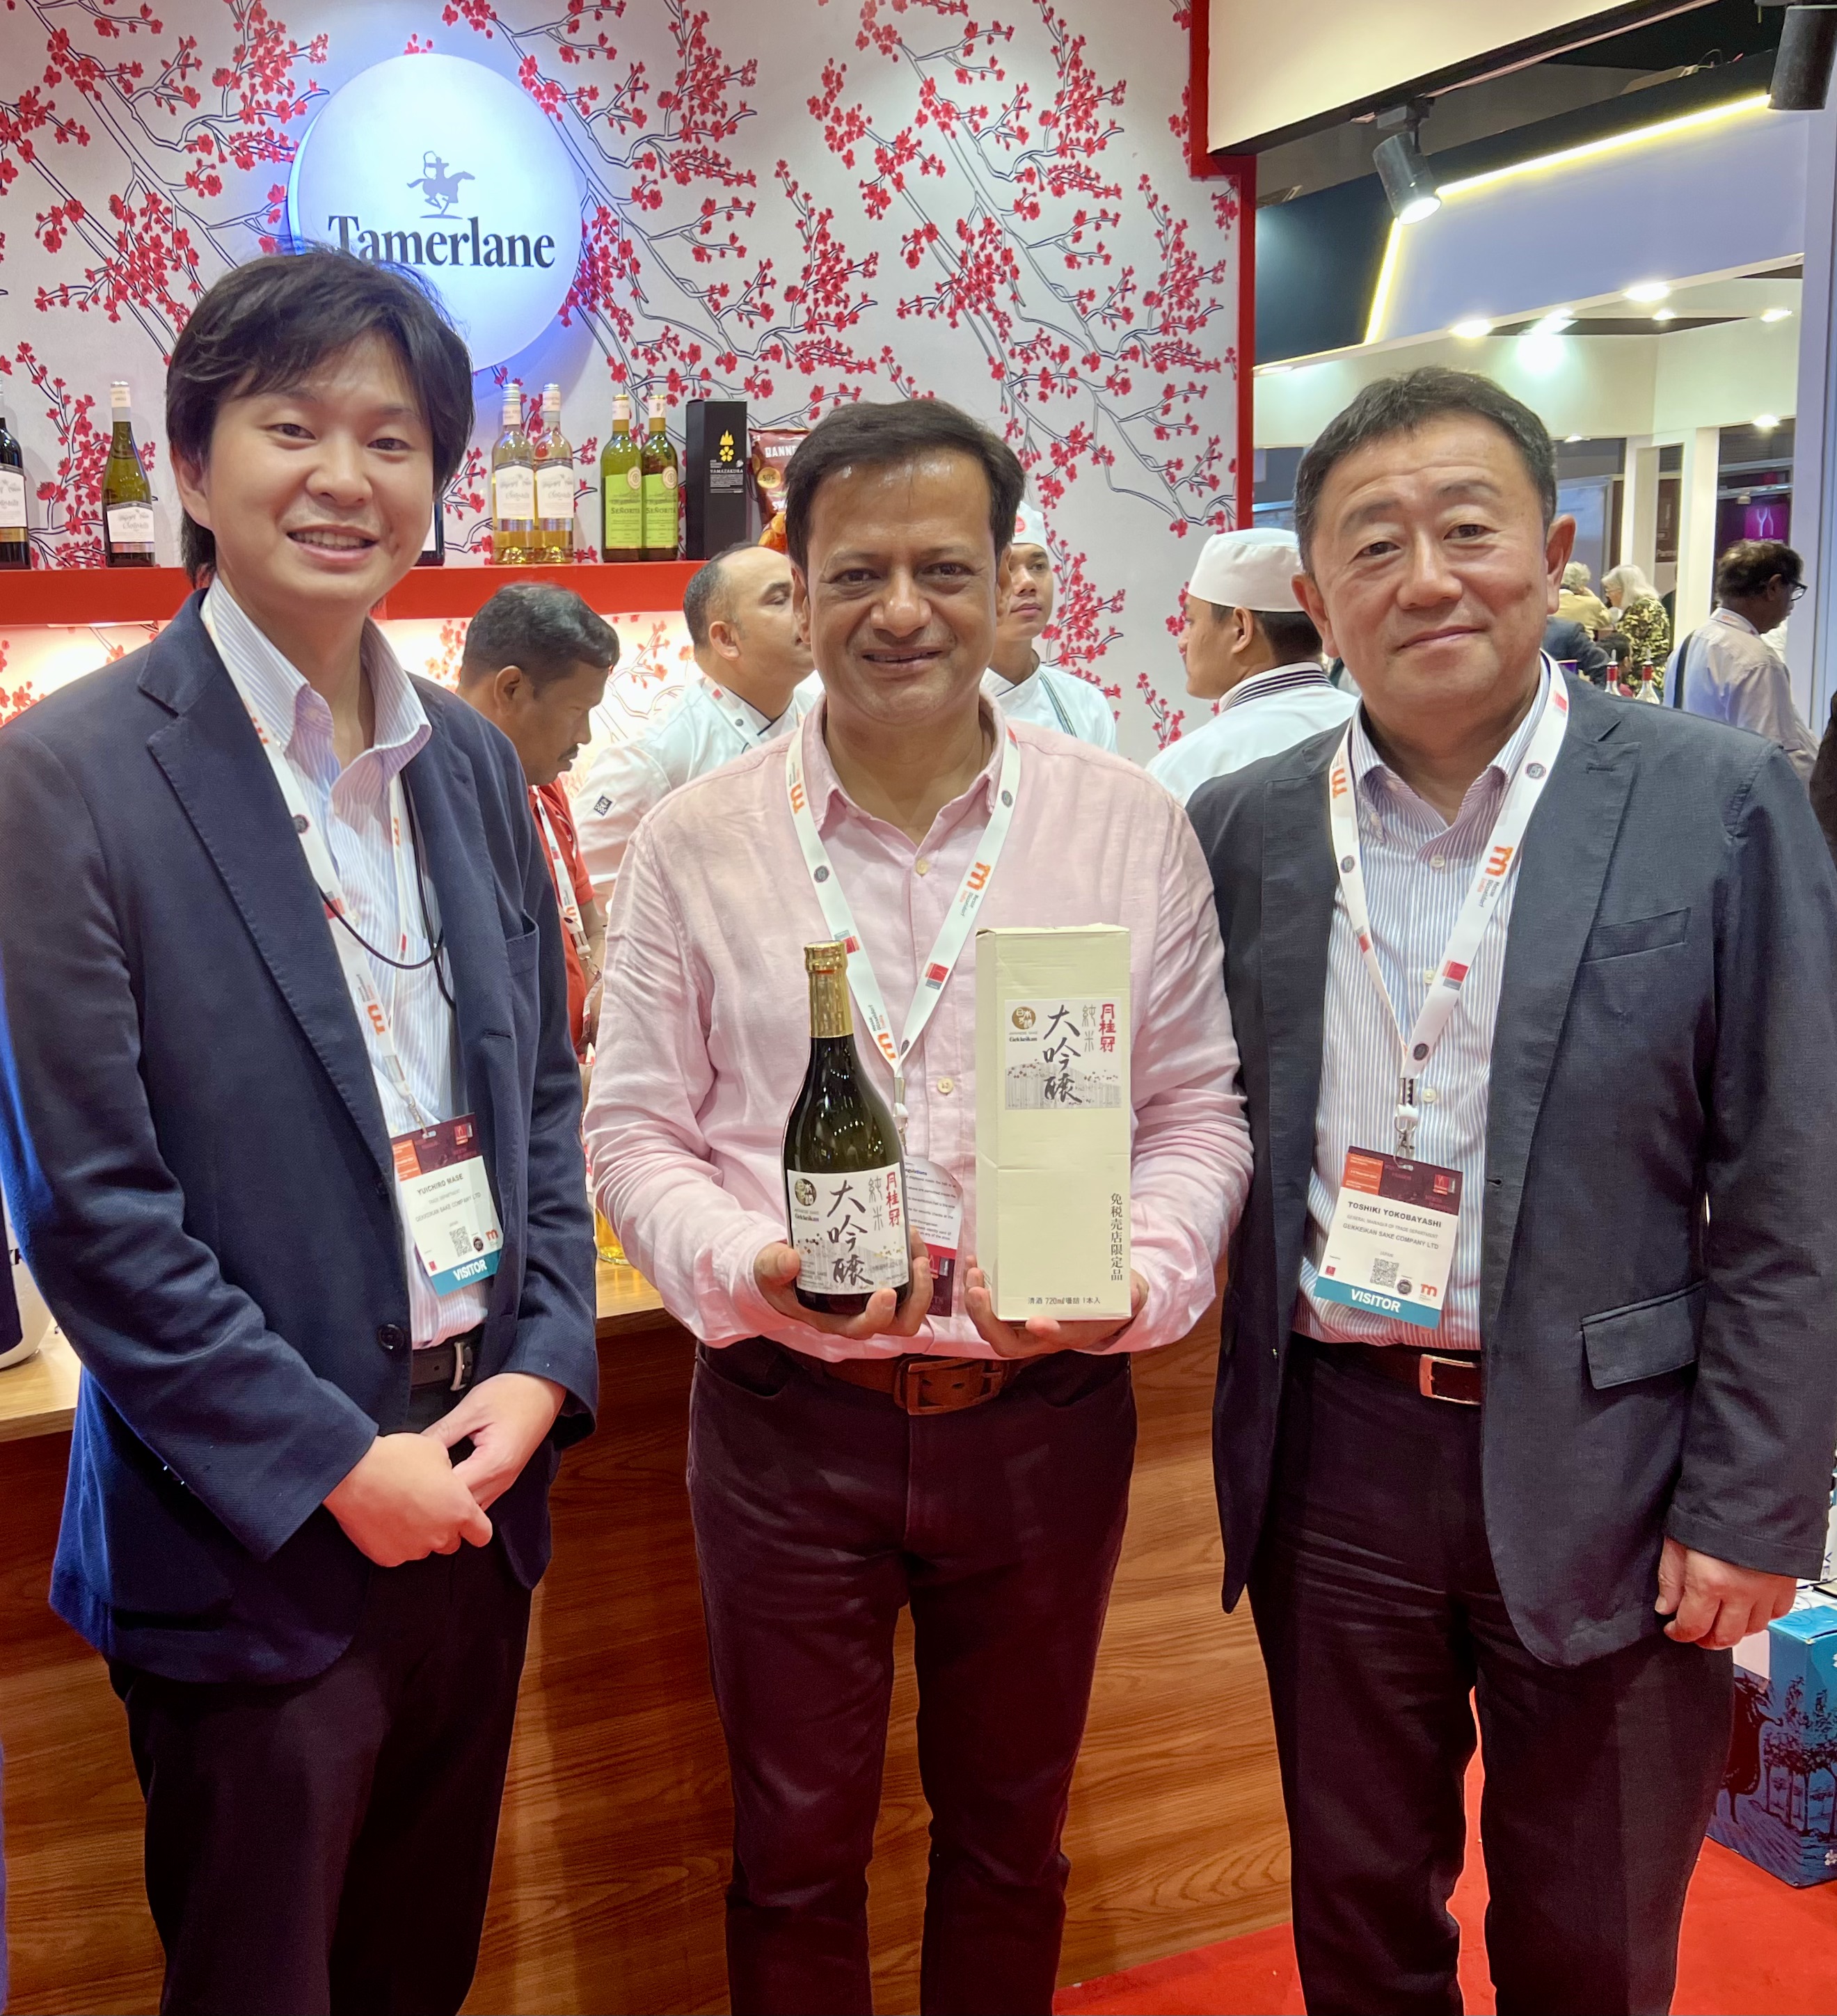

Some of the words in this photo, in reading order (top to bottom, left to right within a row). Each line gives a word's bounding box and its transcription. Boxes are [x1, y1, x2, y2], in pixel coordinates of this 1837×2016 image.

[328, 215, 555, 268] Tamerlane
[447, 1173, 463, 1184] MASE
[1348, 1201, 1381, 1214] TOSHIKI
[1383, 1209, 1442, 1228] YOKOBAYASHI
[1111, 1193, 1123, 1281] 免税売店限定品
[1343, 1223, 1377, 1235] GEKKEIKAN
[1378, 1231, 1394, 1239] SAKE
[1396, 1235, 1426, 1246] COMPANY
[453, 1259, 487, 1281] VISITOR
[1351, 1288, 1401, 1313] VISITOR
